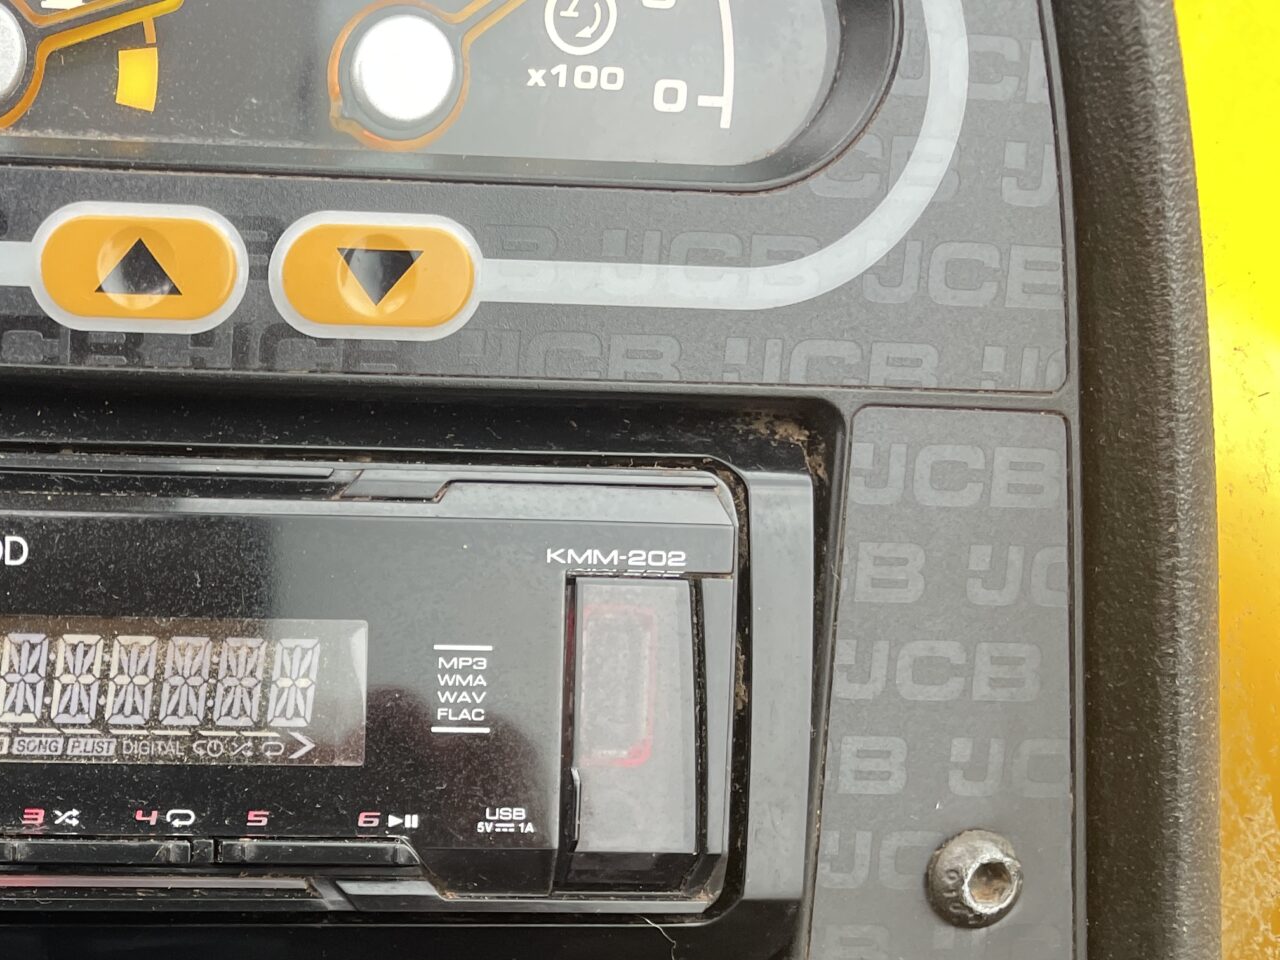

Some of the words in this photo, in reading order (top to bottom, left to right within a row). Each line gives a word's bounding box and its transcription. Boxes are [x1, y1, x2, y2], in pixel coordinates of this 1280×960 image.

[527, 63, 625, 91] x100
[850, 442, 1063, 508] JCB
[546, 547, 687, 567] KMM-202
[438, 656, 488, 670] MP3
[437, 673, 488, 688] WMA
[437, 690, 487, 704] WAV
[436, 707, 486, 721] FLAC
[16, 738, 60, 754] SONG
[121, 740, 186, 756] DIGITAL
[22, 808, 45, 825] 3
[134, 808, 158, 826] 4
[245, 809, 269, 827] 5
[357, 811, 380, 828] 6
[485, 807, 526, 820] USB
[518, 822, 535, 833] 1A
